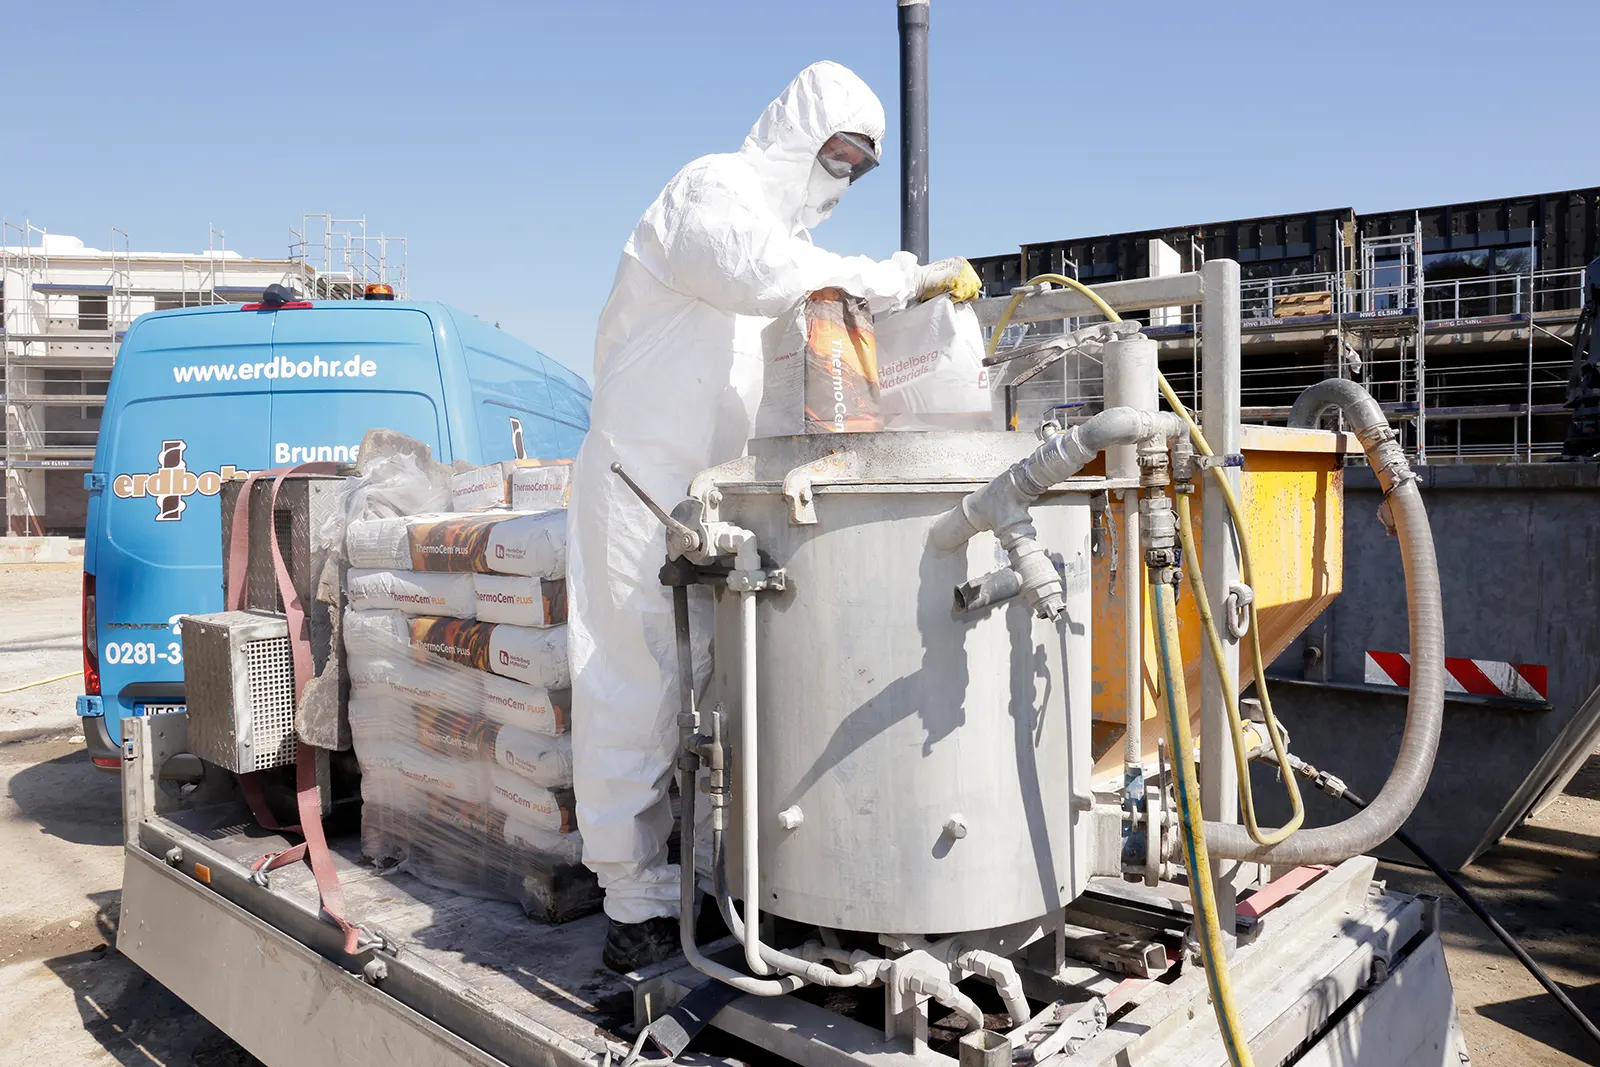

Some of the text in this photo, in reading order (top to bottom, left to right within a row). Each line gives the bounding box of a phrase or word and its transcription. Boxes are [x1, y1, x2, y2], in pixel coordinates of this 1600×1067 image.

[1378, 309, 1403, 317] ELSING
[173, 355, 377, 383] www.erdbohr.de
[878, 350, 939, 377] Heidelberg
[879, 365, 929, 390] Materials
[415, 544, 469, 555] ThermoCem PLUS
[390, 591, 431, 604] ThermoCem
[516, 596, 533, 604] PLUS
[105, 642, 184, 665] 0281-3
[416, 640, 471, 656] ThermoCem PLUS
[527, 705, 546, 714] PLUS
[532, 803, 553, 814] PLUS
